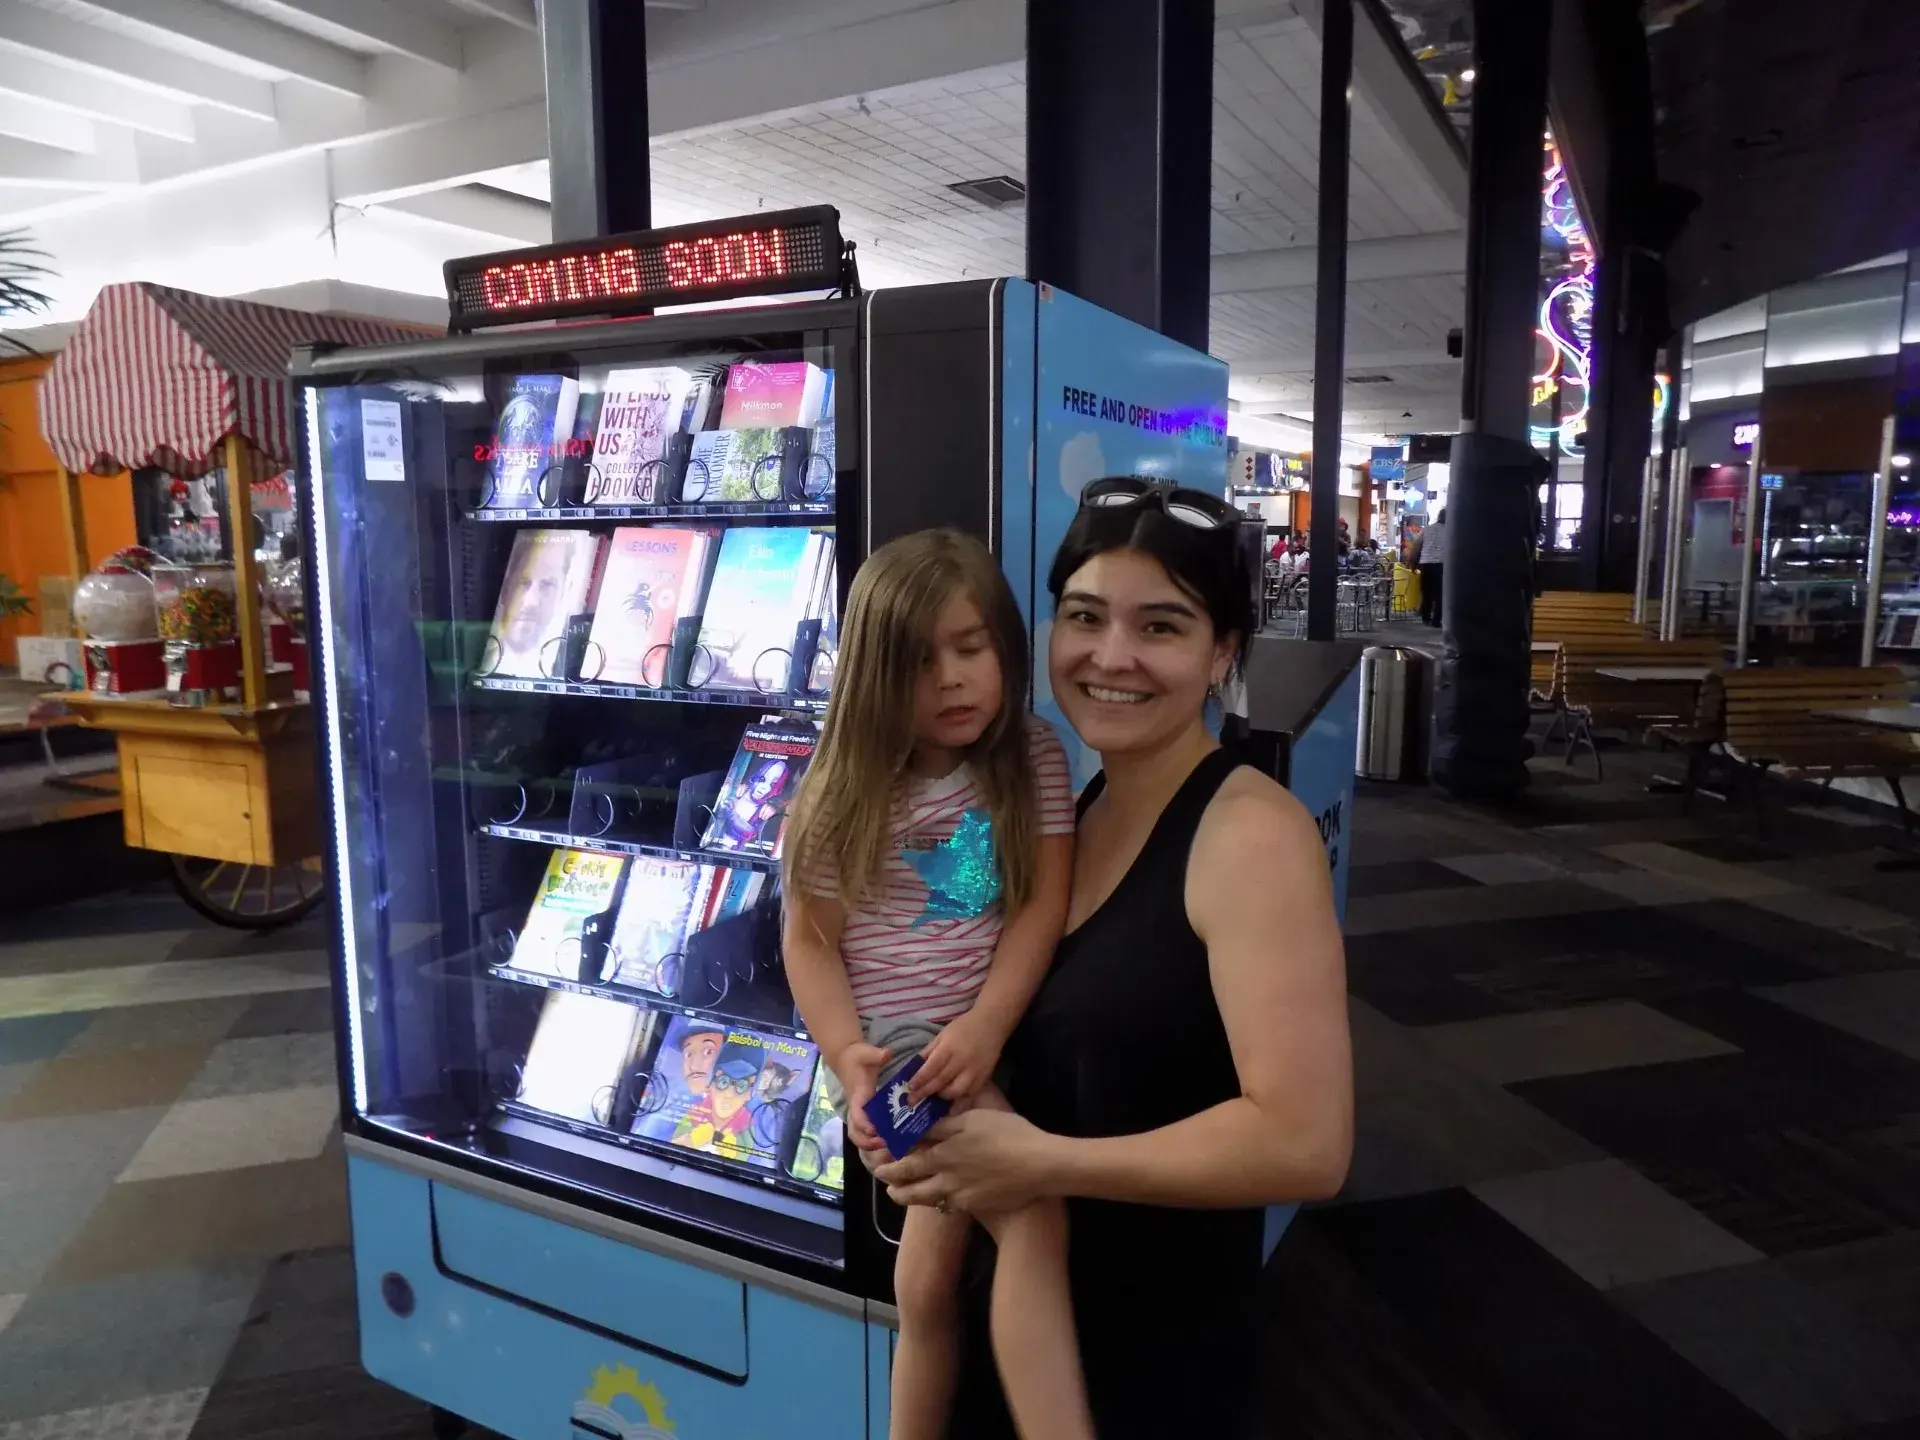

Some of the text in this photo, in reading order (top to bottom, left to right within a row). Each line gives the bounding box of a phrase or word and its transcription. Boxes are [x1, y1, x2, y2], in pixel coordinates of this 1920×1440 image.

[485, 229, 783, 308] COMING SOON
[604, 406, 649, 429] WITH
[741, 401, 783, 411] Milkman
[1063, 385, 1097, 418] FREE
[1100, 396, 1126, 424] AND
[1128, 403, 1158, 432] OPEN
[1160, 412, 1173, 435] TO
[598, 432, 622, 455] US
[692, 447, 713, 484] DEBBIE
[707, 433, 731, 496] MACOMBER
[590, 477, 652, 497] HOOVER
[762, 1041, 774, 1050] en
